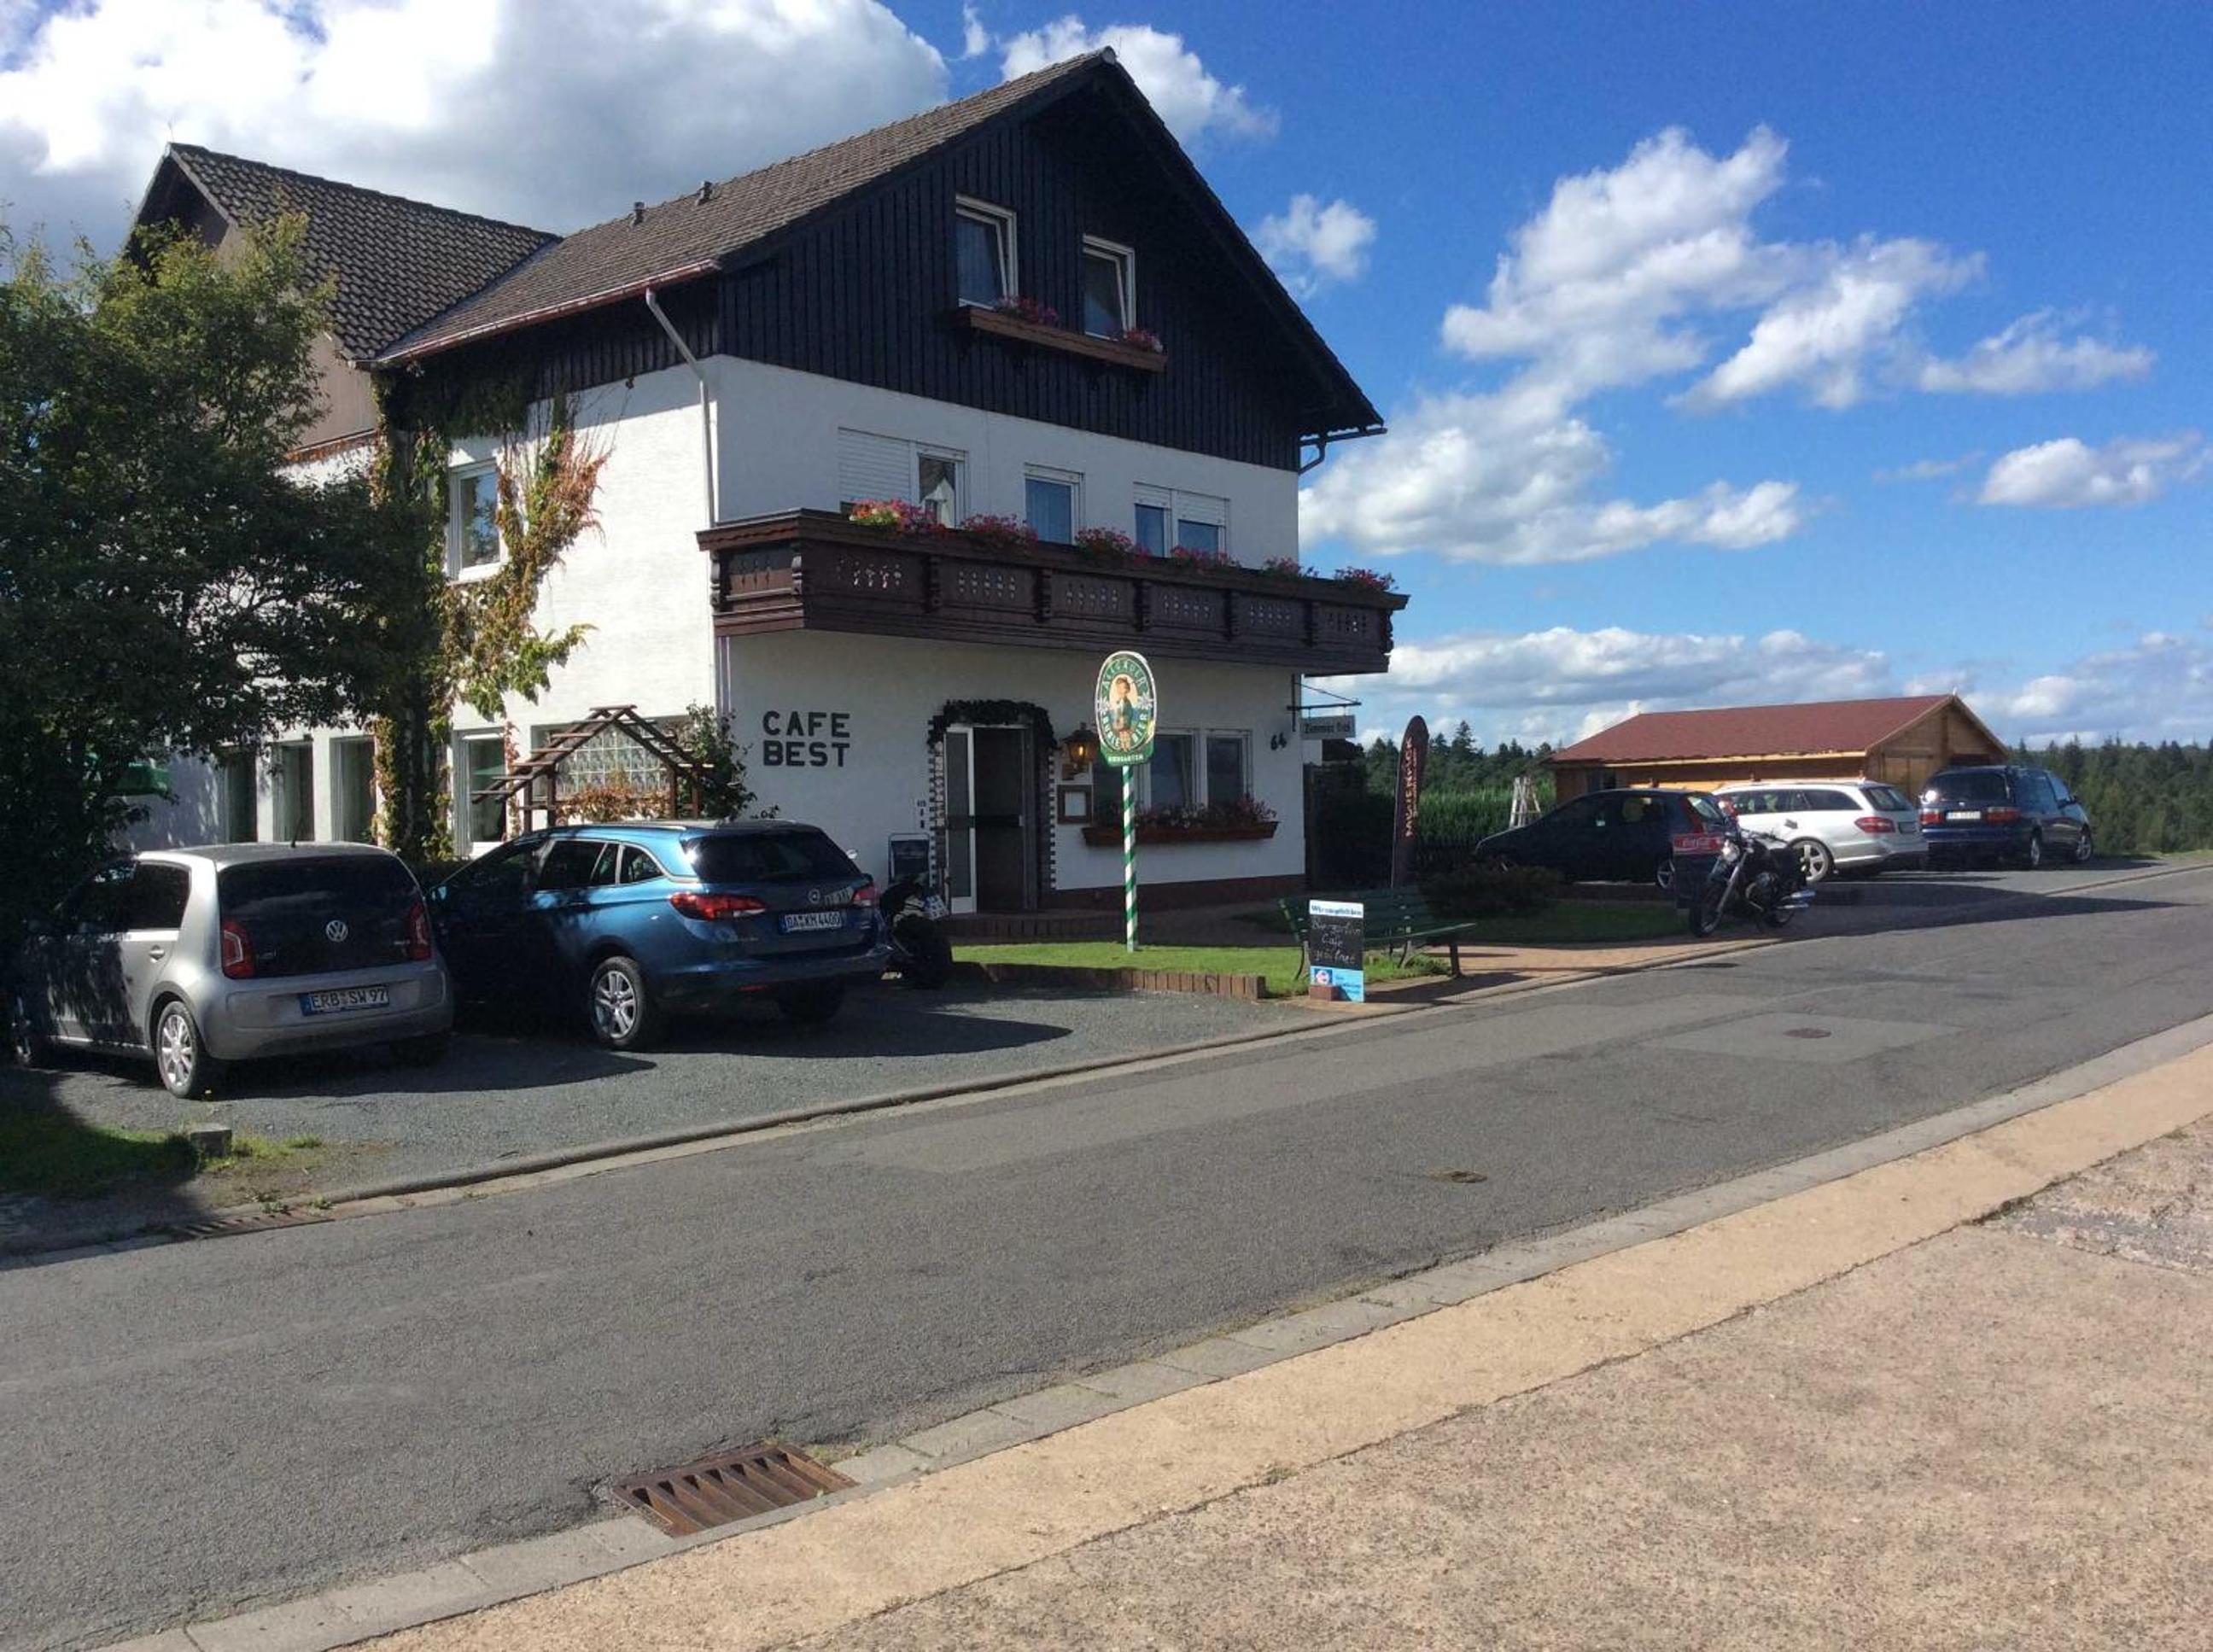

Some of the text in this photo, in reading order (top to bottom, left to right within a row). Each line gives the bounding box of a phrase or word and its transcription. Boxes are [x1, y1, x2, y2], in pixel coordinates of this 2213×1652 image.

[762, 710, 850, 738] CAFE
[1270, 733, 1288, 750] 64
[763, 740, 850, 768] BEST
[370, 988, 387, 1002] 97
